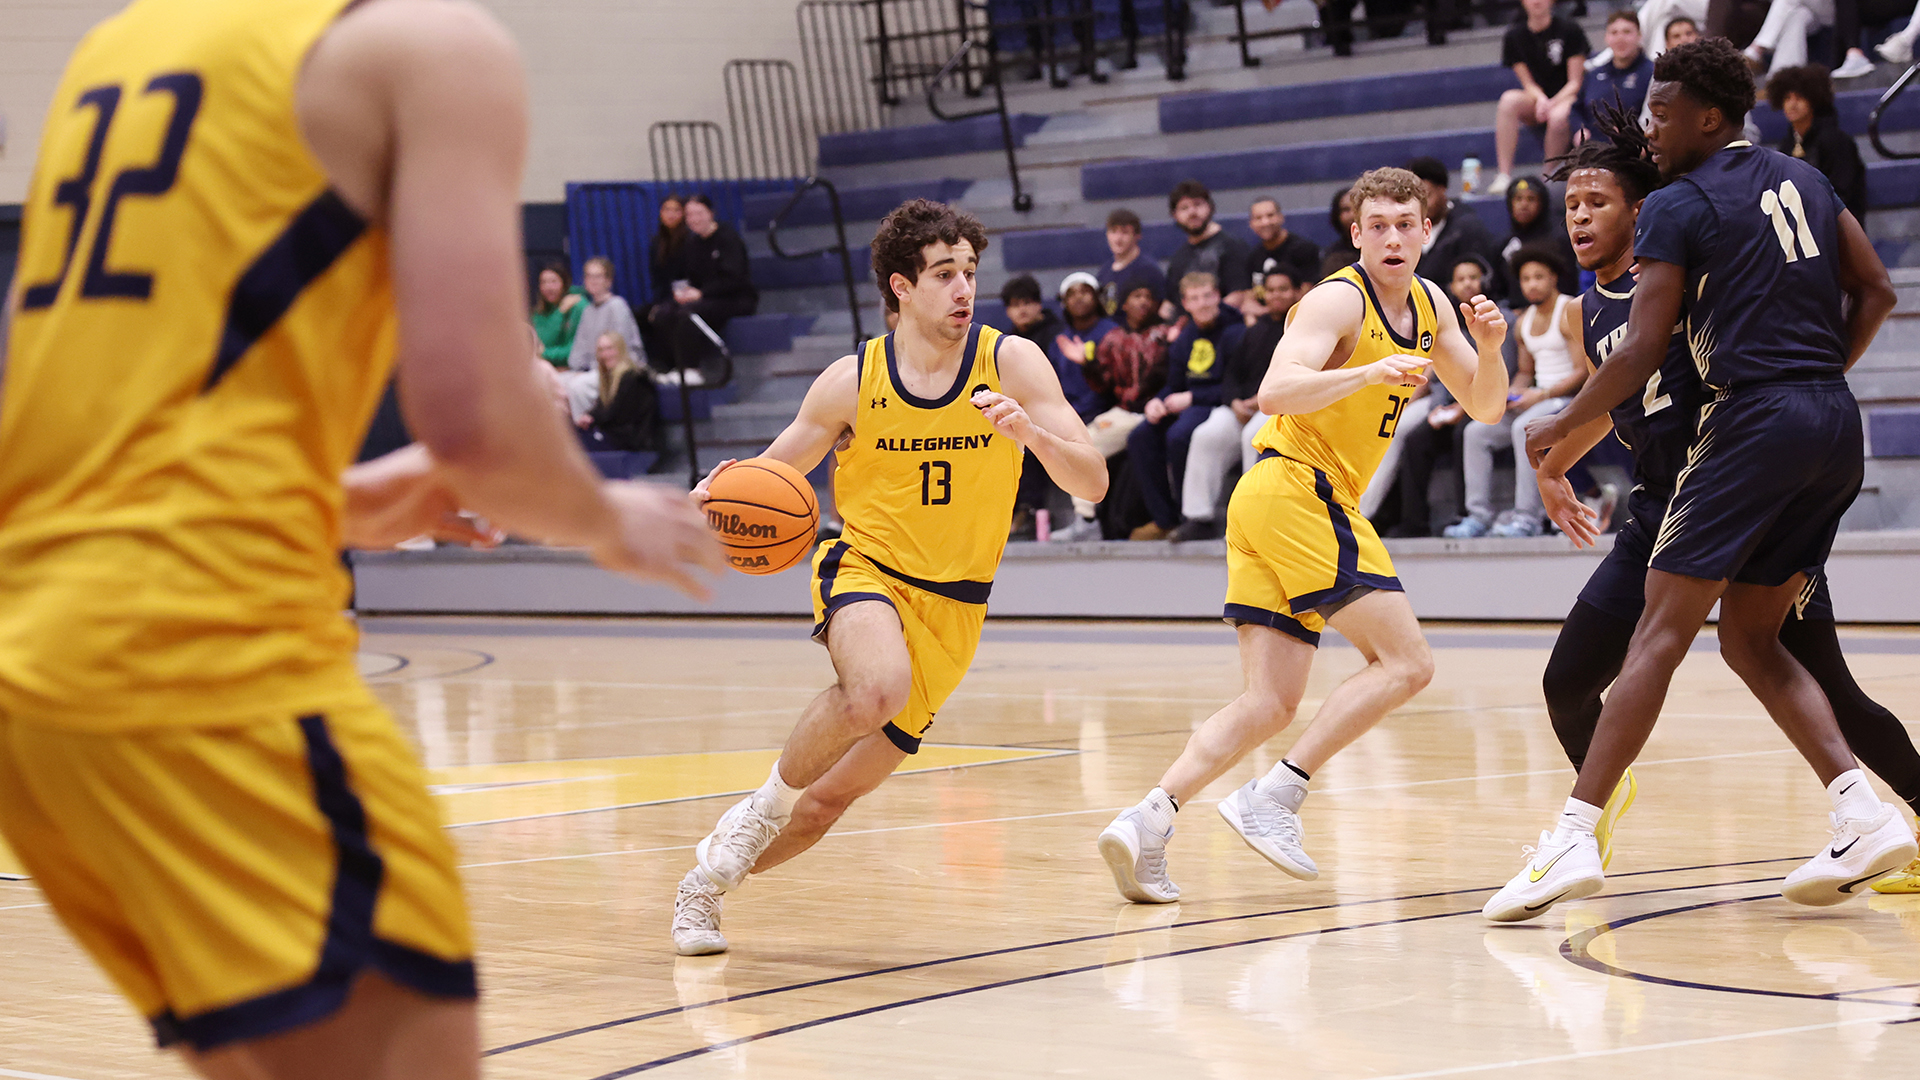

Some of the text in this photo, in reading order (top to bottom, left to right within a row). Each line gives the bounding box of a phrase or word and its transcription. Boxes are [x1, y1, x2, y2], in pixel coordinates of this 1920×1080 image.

[22, 72, 204, 309] 32
[1760, 179, 1821, 263] 11
[875, 433, 993, 452] ALLEGHENY
[919, 460, 951, 505] 13
[708, 509, 777, 538] Wilson
